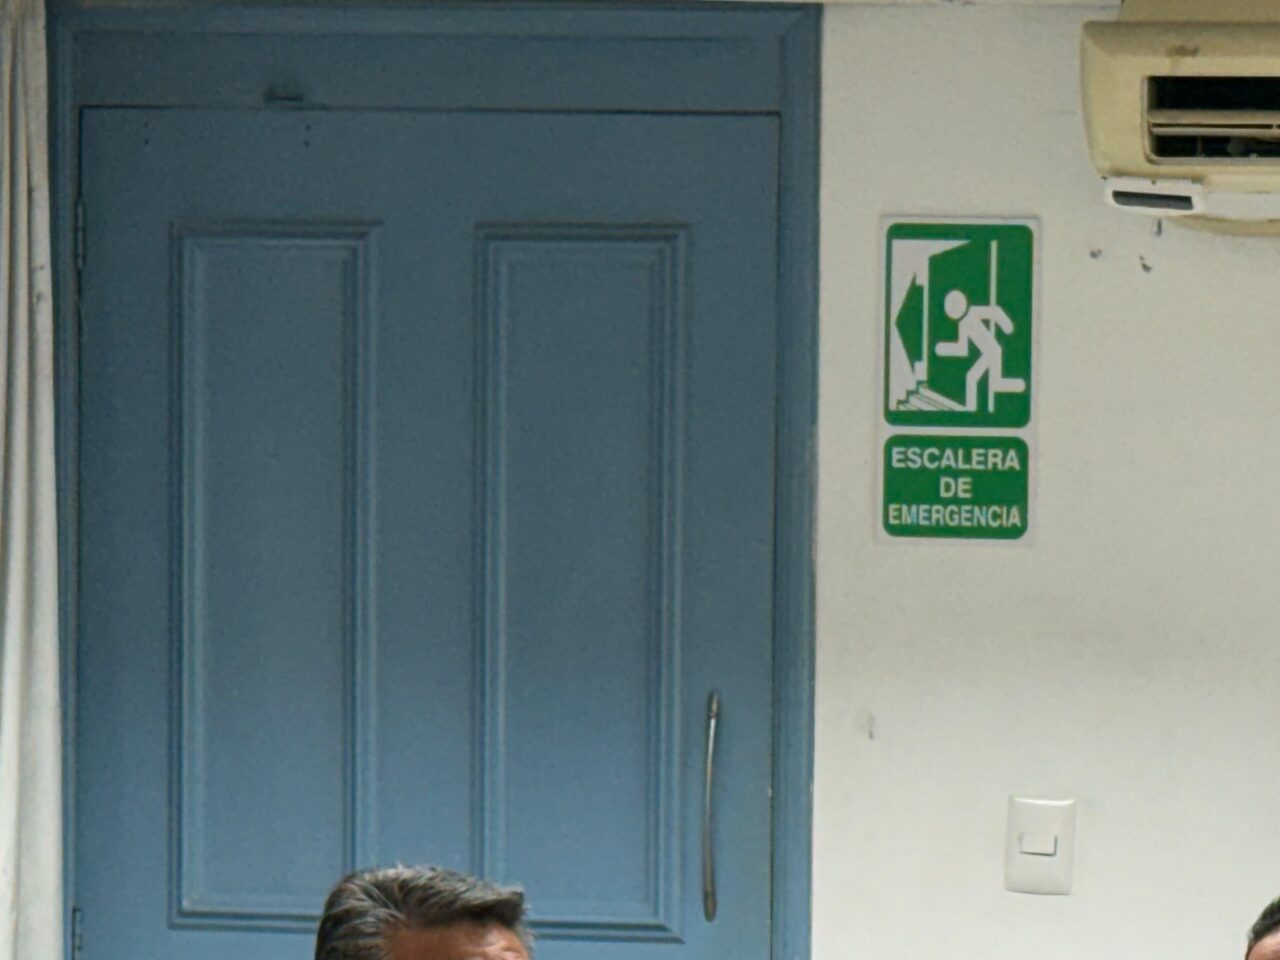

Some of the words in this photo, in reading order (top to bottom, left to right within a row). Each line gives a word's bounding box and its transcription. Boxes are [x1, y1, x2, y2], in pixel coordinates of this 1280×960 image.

[891, 446, 1021, 471] ESCALERA
[939, 476, 973, 499] DE
[888, 504, 1022, 528] EMERGENCIA
